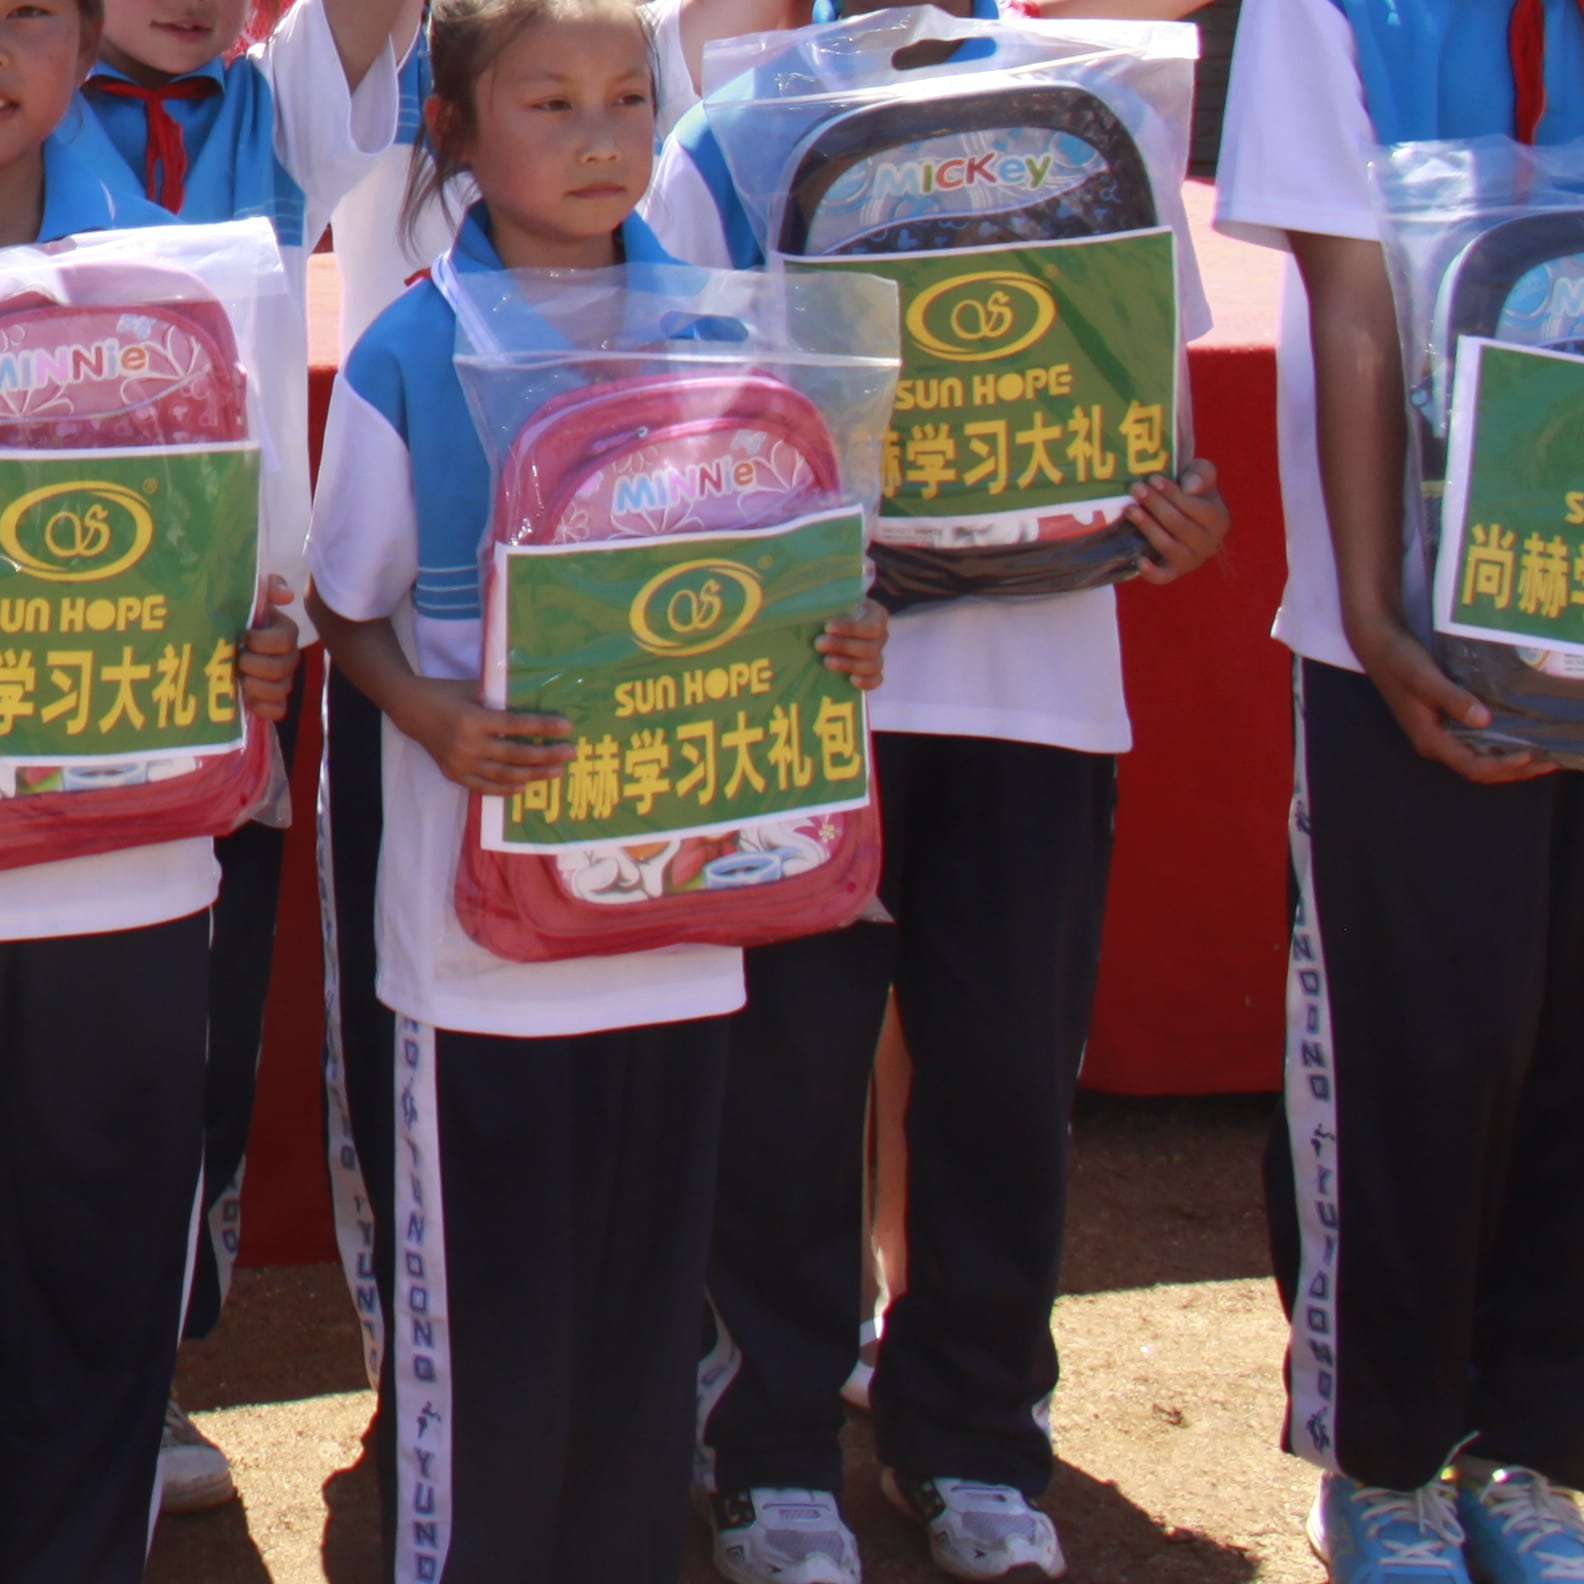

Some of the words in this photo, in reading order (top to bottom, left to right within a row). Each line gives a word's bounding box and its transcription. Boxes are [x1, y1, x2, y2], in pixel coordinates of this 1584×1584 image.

[893, 377, 964, 410] SUN
[973, 364, 1074, 406] HOPE
[59, 594, 168, 633] HOPE
[615, 675, 677, 718] SUN
[684, 658, 773, 706] HOPE
